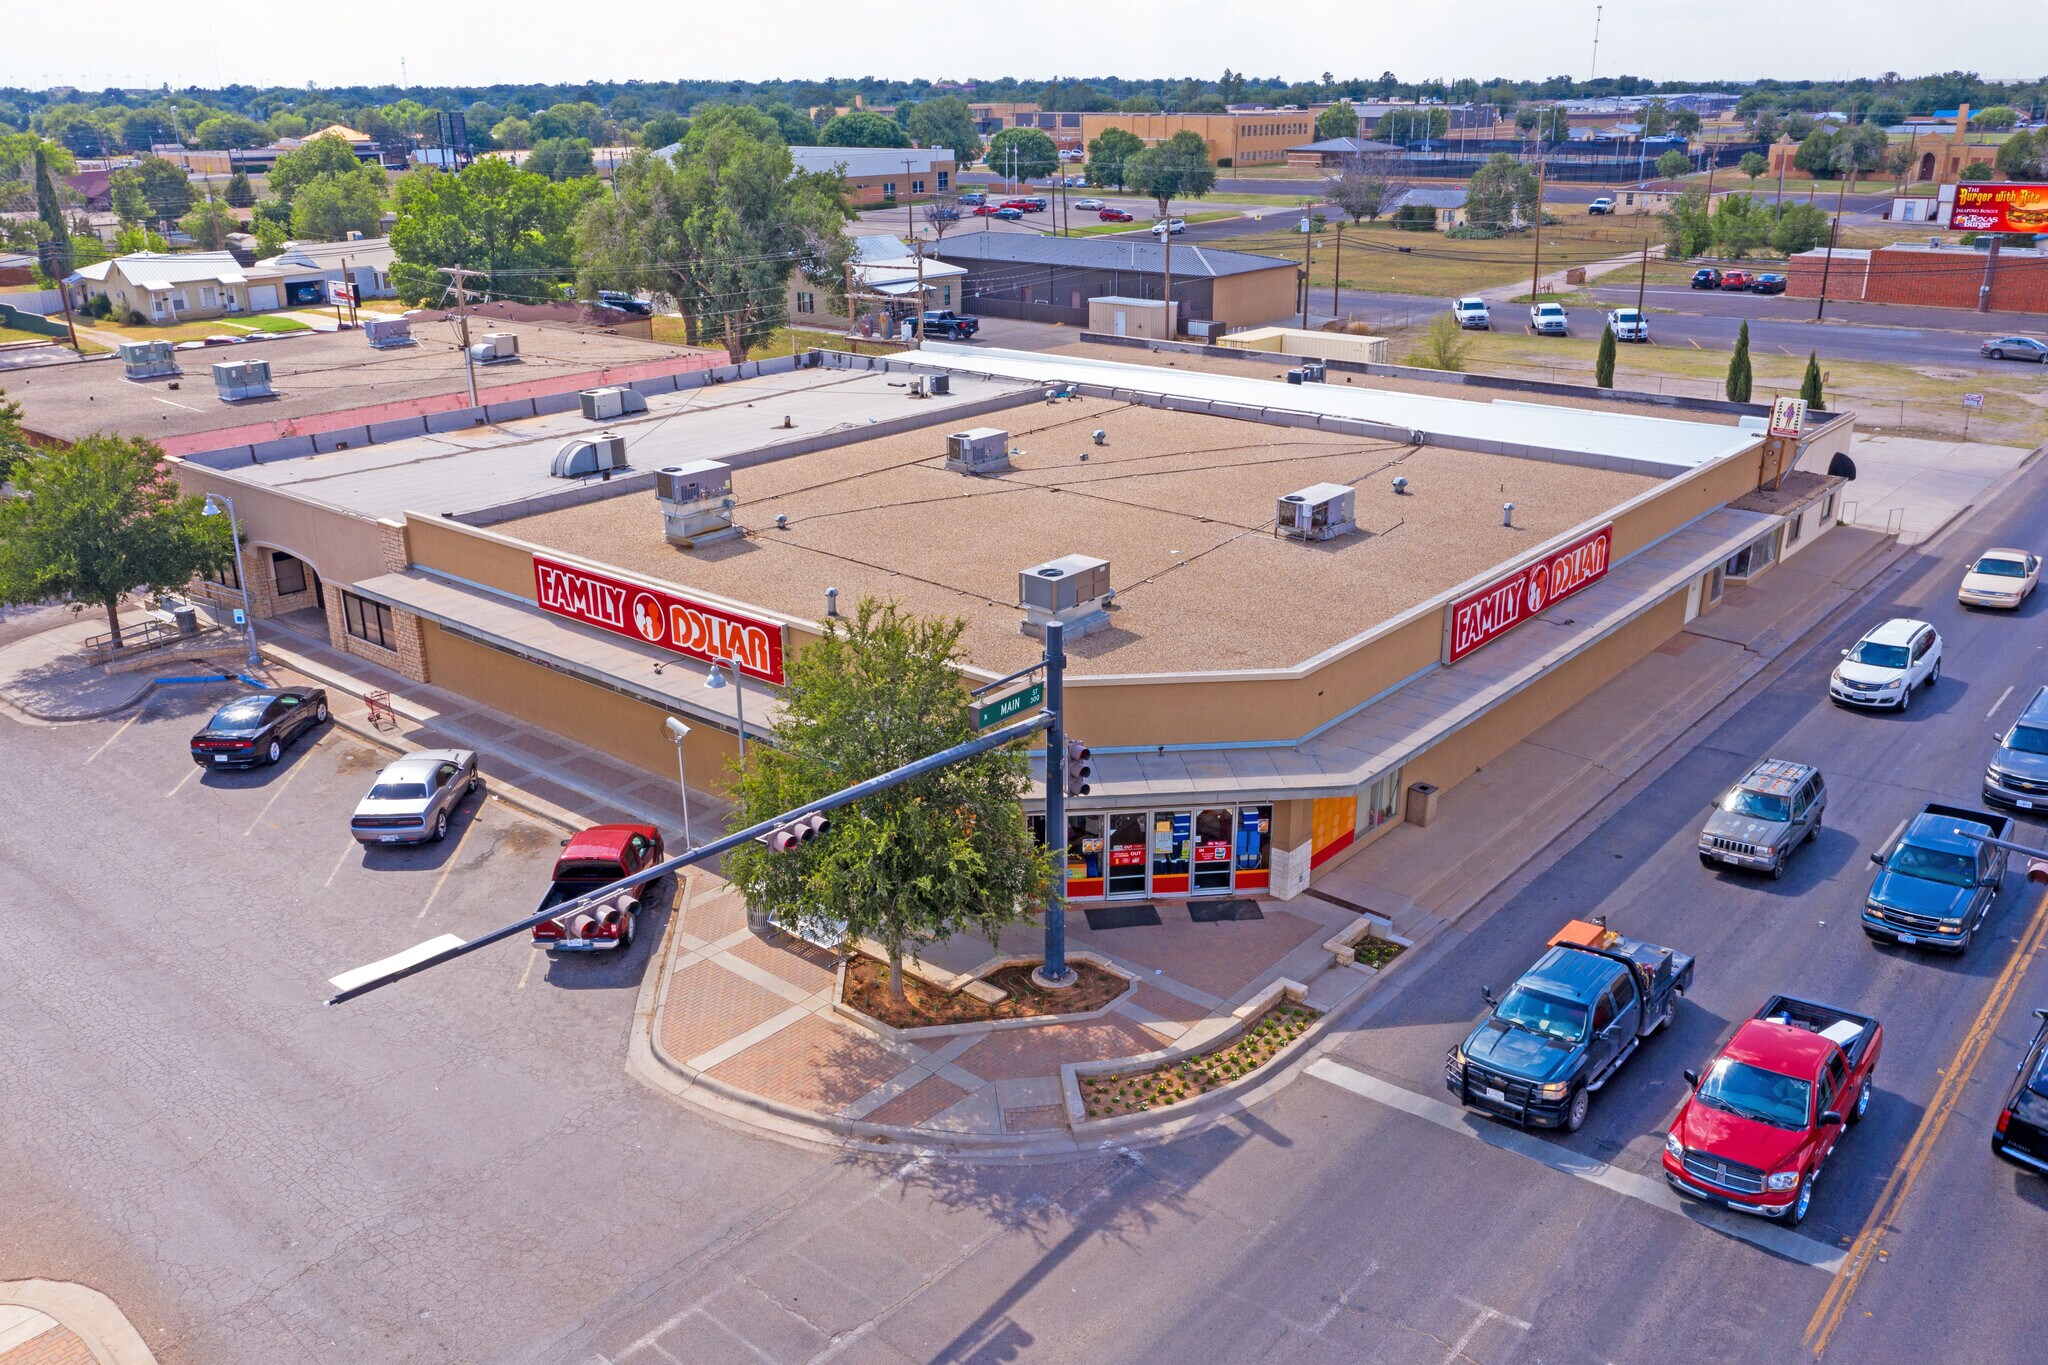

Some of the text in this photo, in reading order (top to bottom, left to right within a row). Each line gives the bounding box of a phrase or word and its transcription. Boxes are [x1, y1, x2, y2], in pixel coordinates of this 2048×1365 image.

[1959, 188, 2041, 207] Burger with Bite
[538, 565, 771, 675] FAMILY DOLLAR
[1456, 535, 1606, 653] FAMILY DOLLAR
[1001, 697, 1020, 716] MAIN
[1032, 688, 1038, 696] ST
